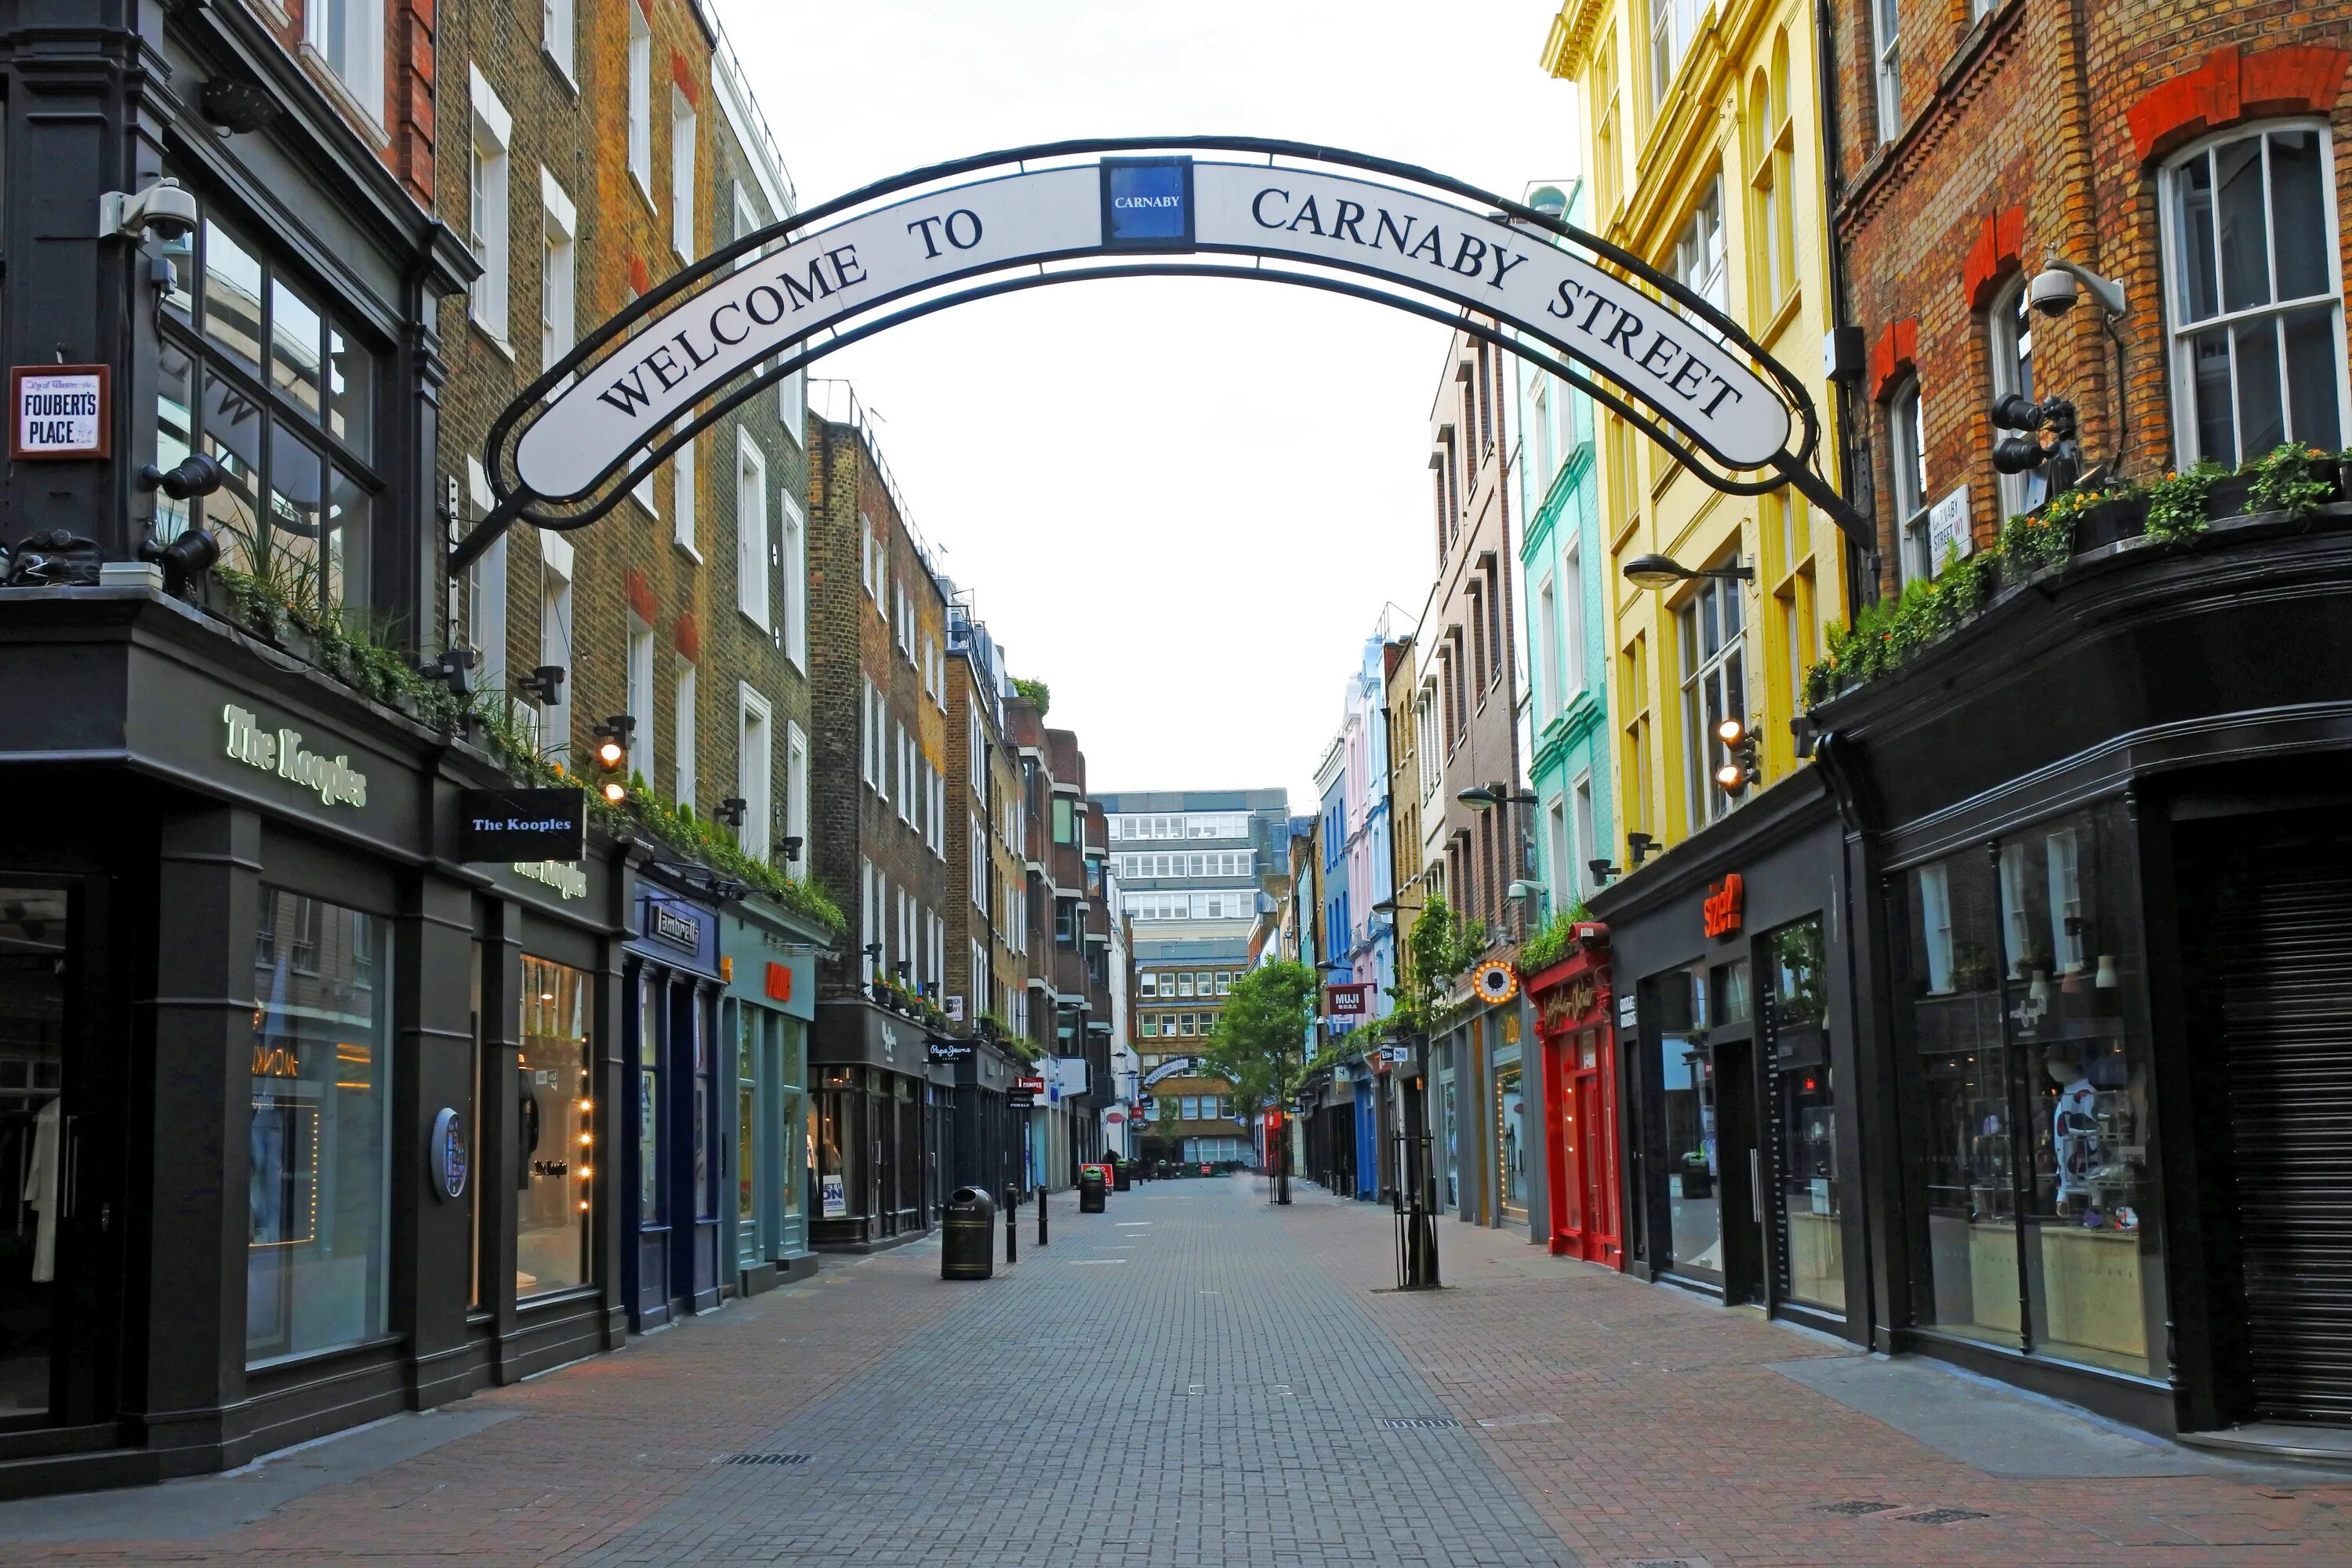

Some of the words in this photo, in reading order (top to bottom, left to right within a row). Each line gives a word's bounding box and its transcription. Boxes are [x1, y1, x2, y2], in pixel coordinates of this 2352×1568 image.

[1115, 196, 1179, 208] CARNABY
[597, 244, 867, 418] WELCOME
[907, 209, 983, 260] TO
[1251, 188, 1528, 291] CARNABY
[1547, 279, 1742, 421] STREET
[25, 392, 96, 416] FOUBERT'S
[1933, 497, 1958, 531] CARNABY
[1933, 524, 1953, 552] STREET
[1954, 517, 1963, 537] W1
[223, 704, 275, 770] The
[278, 728, 366, 808] Kooples
[473, 819, 503, 831] The
[506, 818, 571, 832] Kooples
[657, 906, 699, 949] Lambretta
[1335, 993, 1359, 1004] MUJI
[930, 1044, 948, 1057] Pepe
[947, 1045, 971, 1057] Jeans
[1149, 1065, 1173, 1082] WELCOME
[823, 1189, 843, 1200] ON
